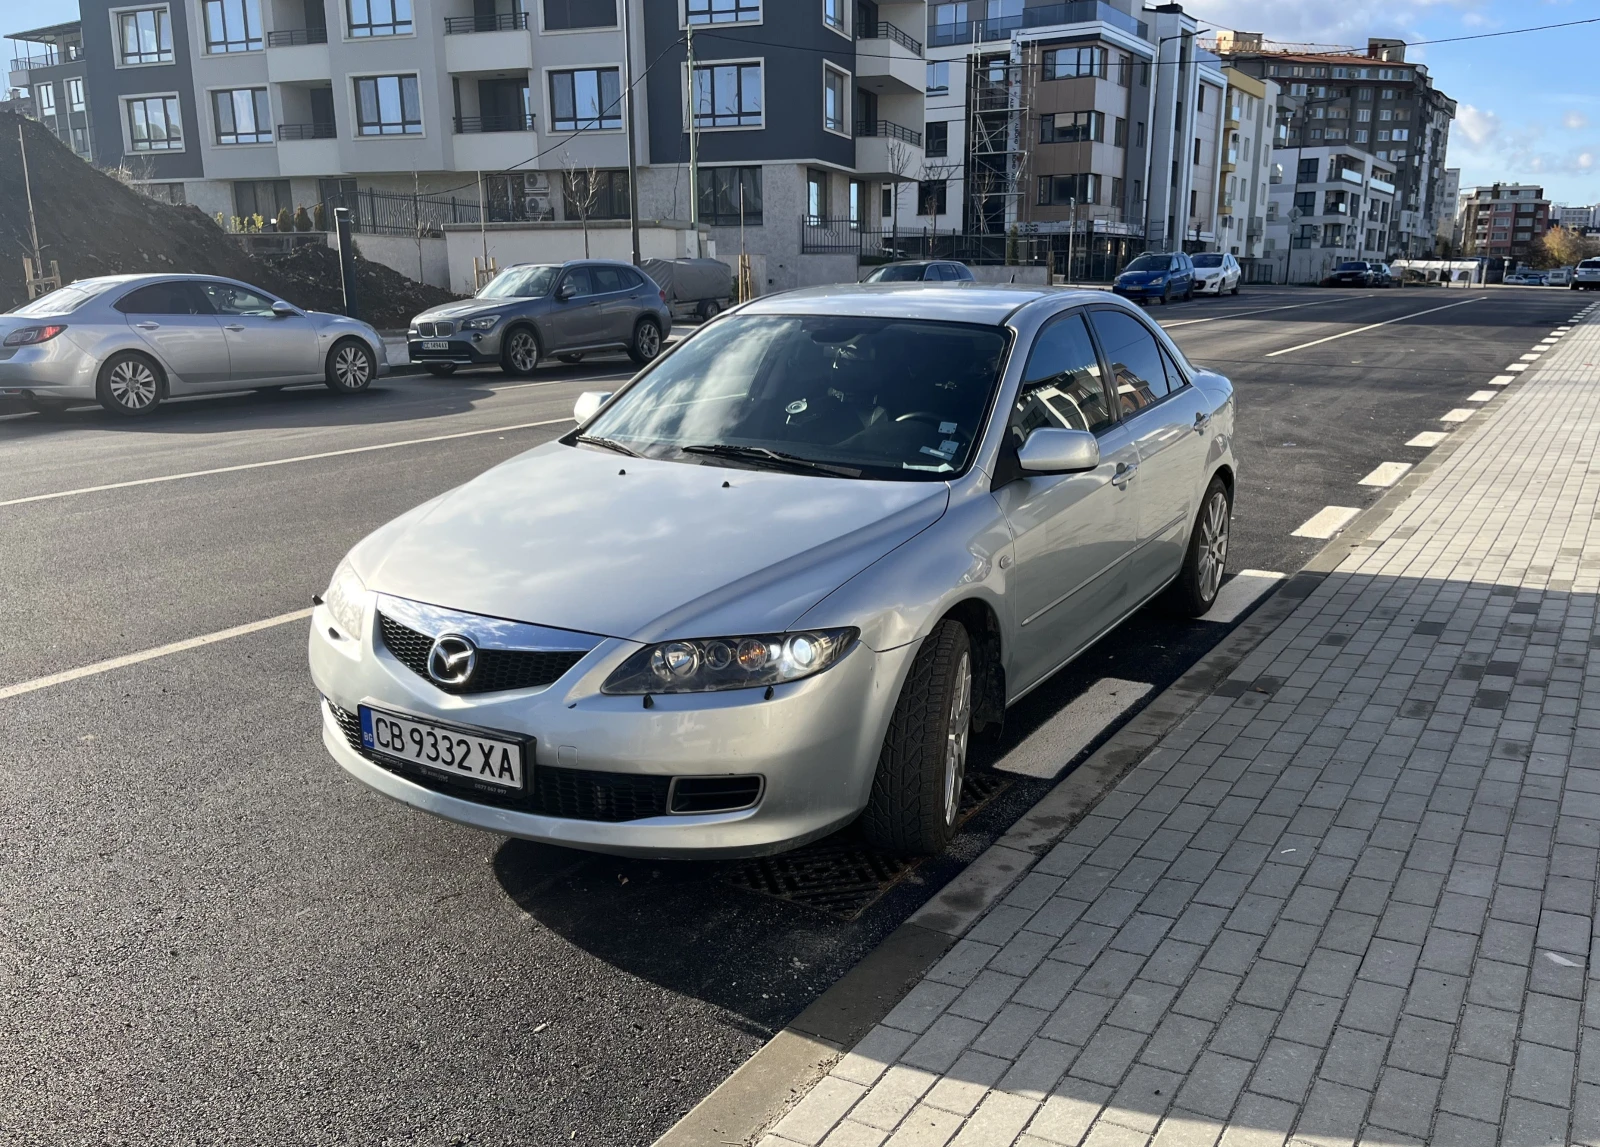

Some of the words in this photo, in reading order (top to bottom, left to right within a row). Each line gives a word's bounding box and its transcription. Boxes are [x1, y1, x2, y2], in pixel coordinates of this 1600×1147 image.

[363, 731, 373, 743] BG
[375, 717, 405, 752] CB
[409, 727, 473, 772] 9332
[478, 742, 515, 781] XA
